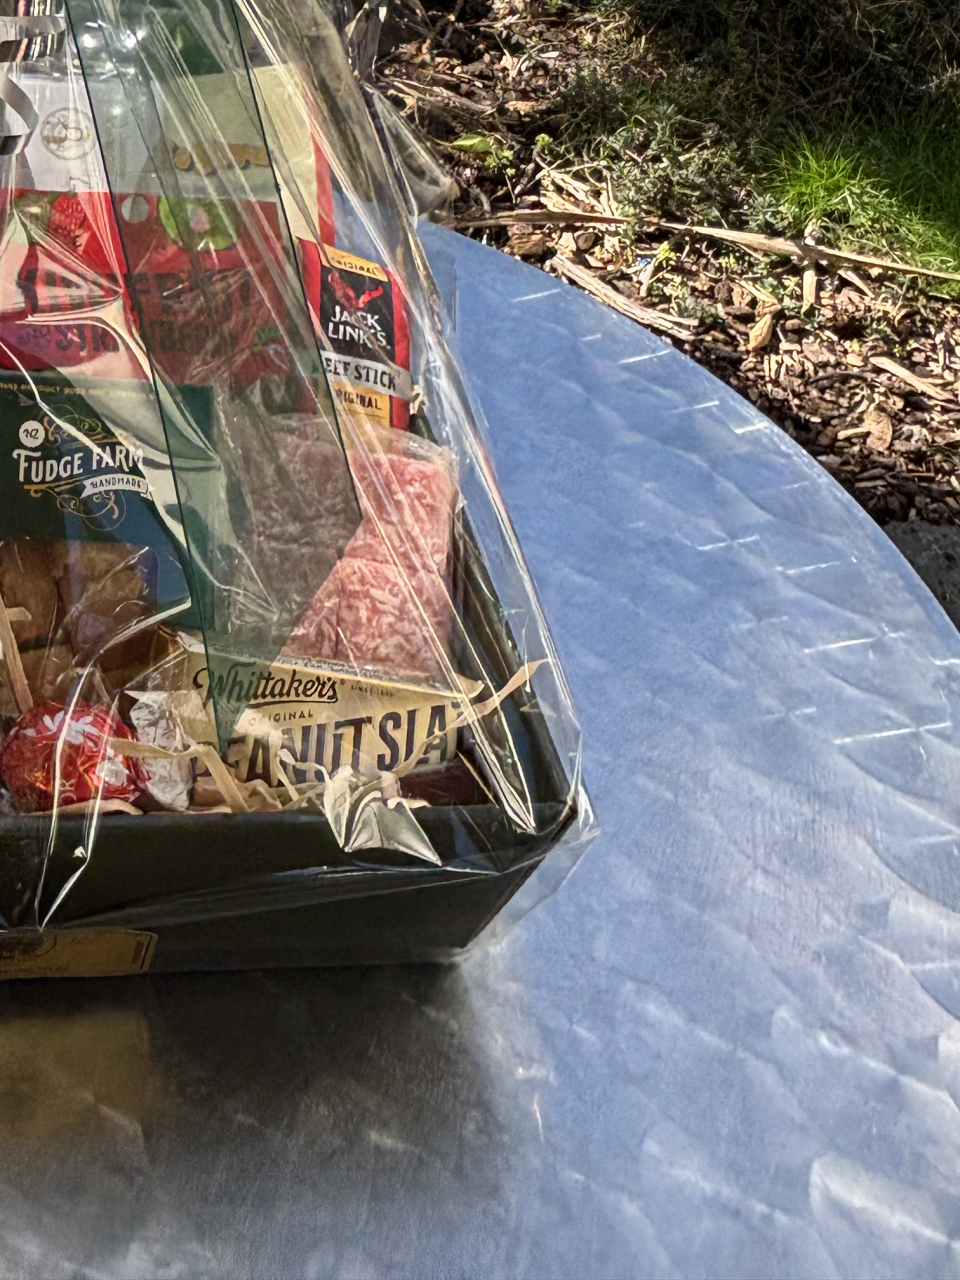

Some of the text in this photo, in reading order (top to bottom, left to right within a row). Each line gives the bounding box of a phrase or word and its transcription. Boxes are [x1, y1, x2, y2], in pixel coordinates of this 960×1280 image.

[330, 305, 381, 331] JACK
[354, 361, 398, 391] STICK
[12, 444, 144, 483] FUDGE FARM
[193, 662, 338, 704] Whittaker's
[248, 709, 314, 727] OIGINAL
